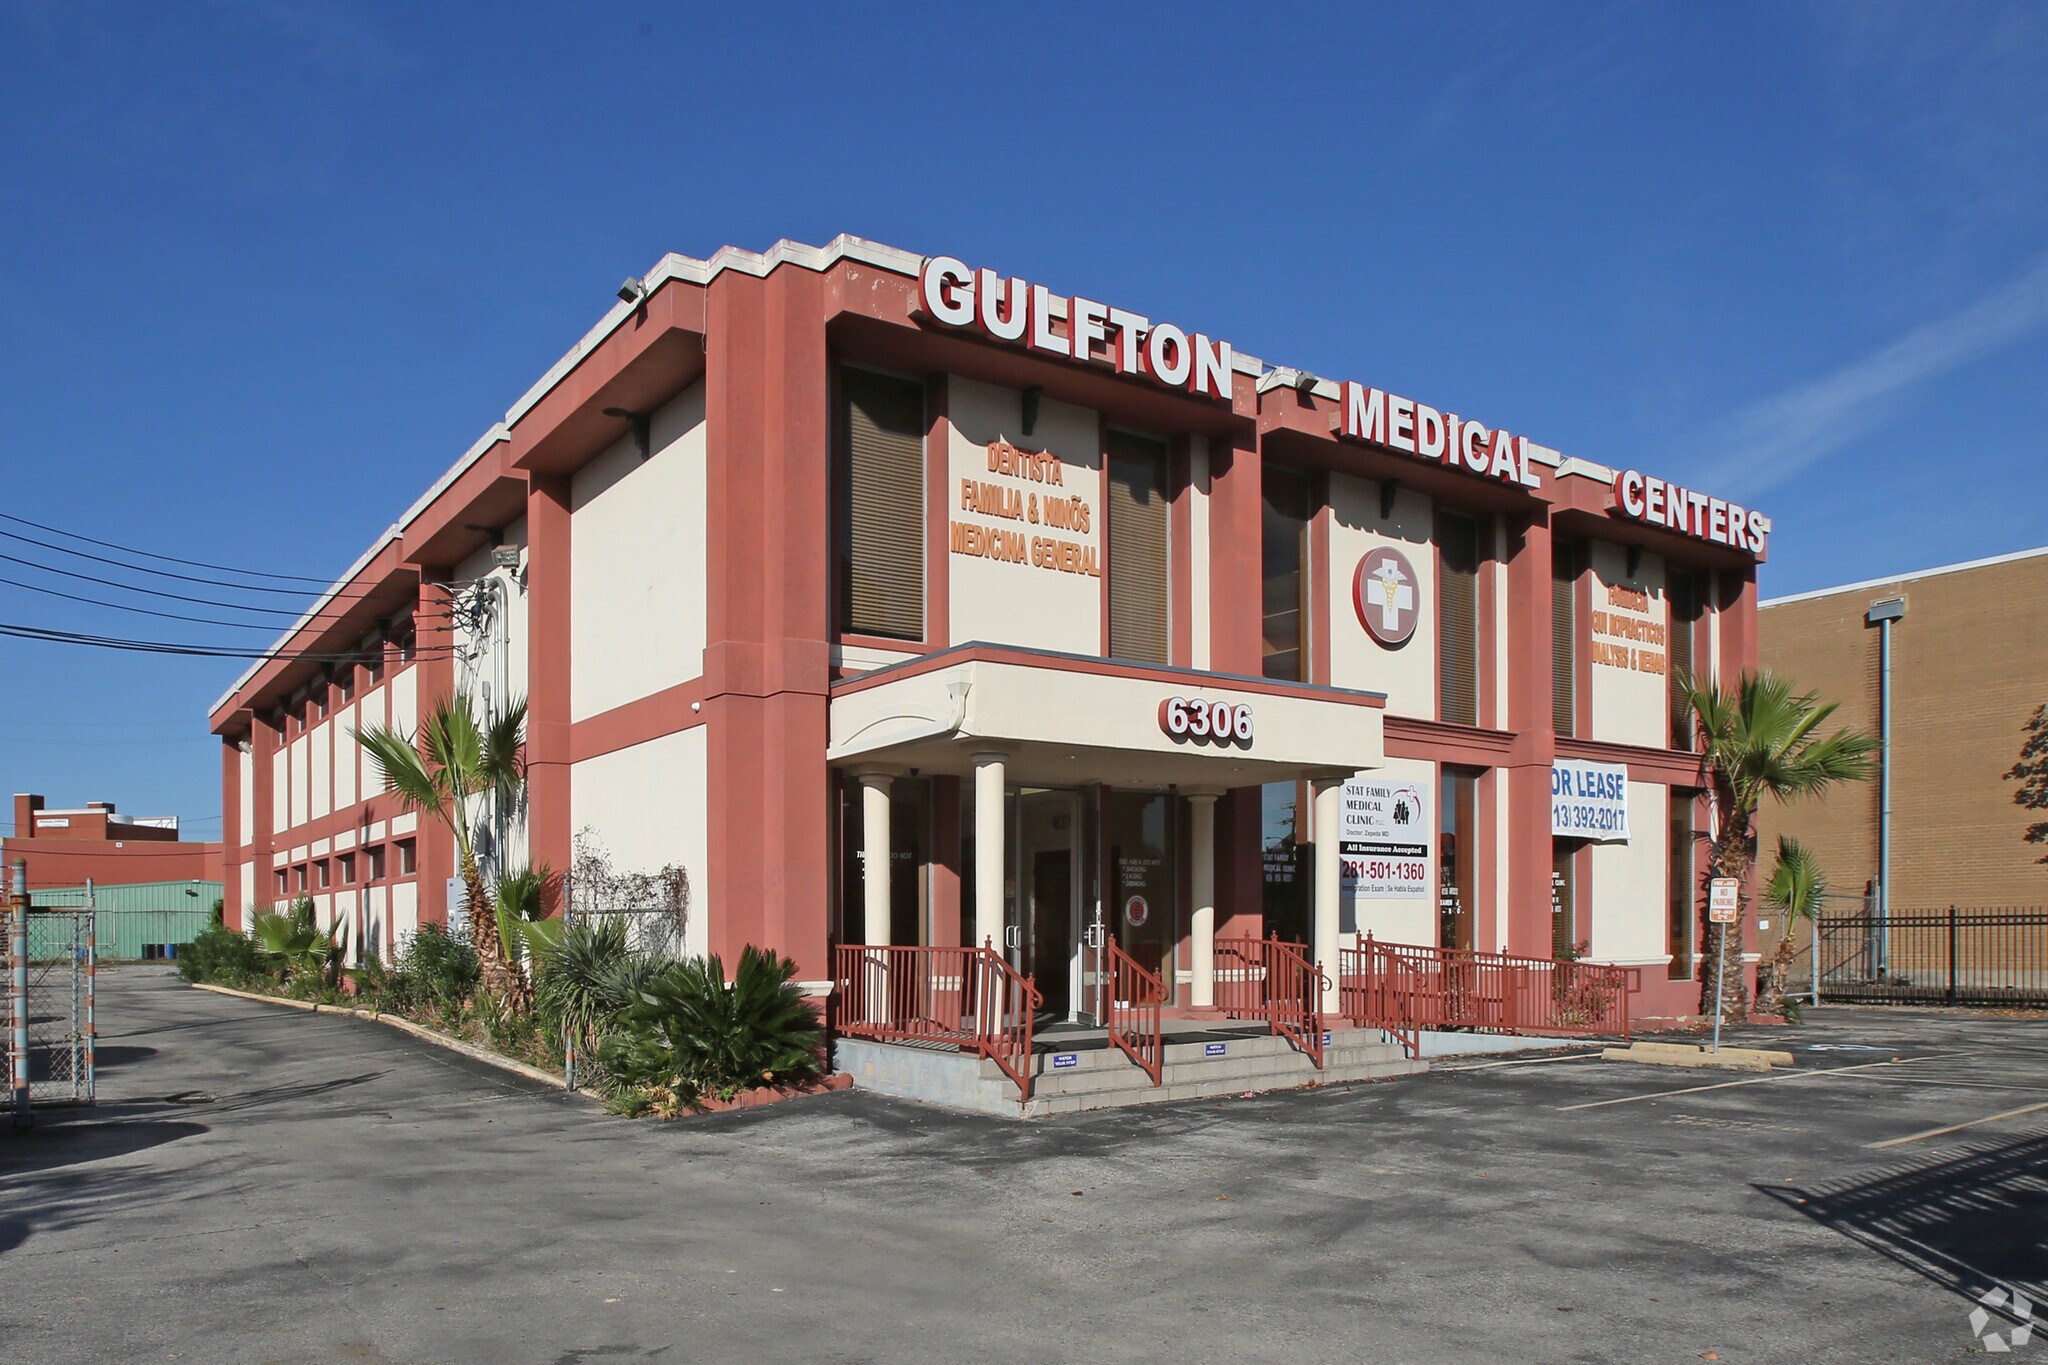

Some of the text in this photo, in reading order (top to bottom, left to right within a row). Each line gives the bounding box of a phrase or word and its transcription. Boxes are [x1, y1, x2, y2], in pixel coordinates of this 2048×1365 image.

[919, 255, 1766, 553] GULFTON MEDICAL CENTERS
[986, 441, 1064, 487] DENTISTA
[961, 477, 1025, 522] FAMILIA
[1027, 492, 1040, 525] &
[950, 520, 1101, 577] MEDICINA GENERAL
[1158, 696, 1254, 742] 6306
[1346, 785, 1391, 798] STAT FAMILY
[1552, 767, 1624, 800] OR LEASE
[1346, 800, 1383, 812] MEDICAL
[1346, 814, 1375, 826] CLINIC
[1346, 844, 1422, 855] All Insurance Accepted
[1342, 860, 1425, 881] 281-501-1360
[1371, 884, 1385, 893] Exam
[1720, 888, 1728, 896] NO
[1712, 898, 1734, 906] PARKING
